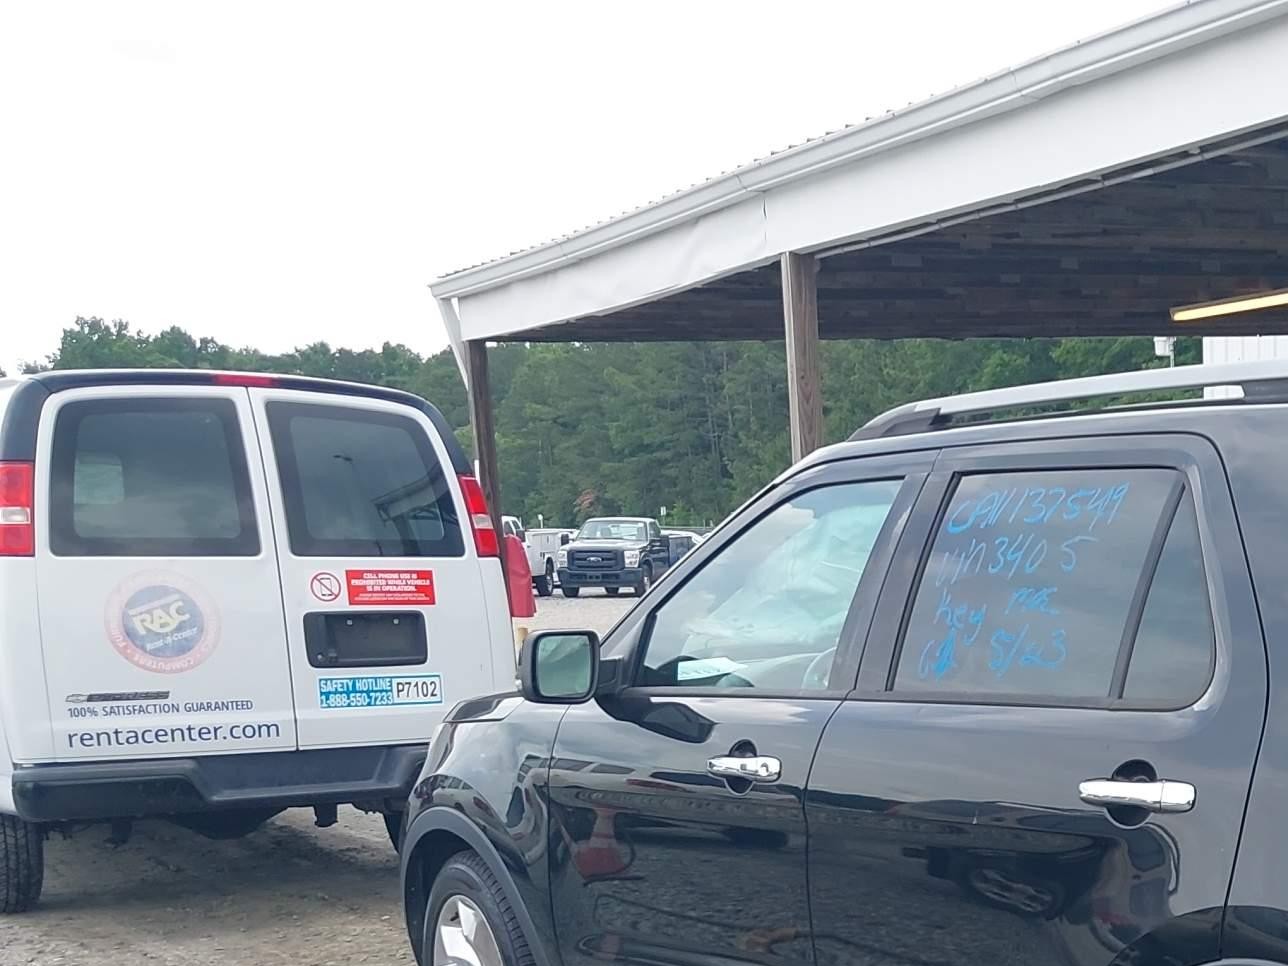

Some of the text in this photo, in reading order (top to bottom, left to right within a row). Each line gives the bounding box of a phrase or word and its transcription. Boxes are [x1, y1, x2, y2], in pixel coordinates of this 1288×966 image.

[320, 677, 392, 692] SAFETY HOTLINE
[396, 681, 438, 698] P7102
[321, 692, 393, 707] 1-888-550-7233
[67, 700, 254, 718] 100% SATISFACTION GUARANTEED
[67, 722, 281, 748] rentacenter.com
